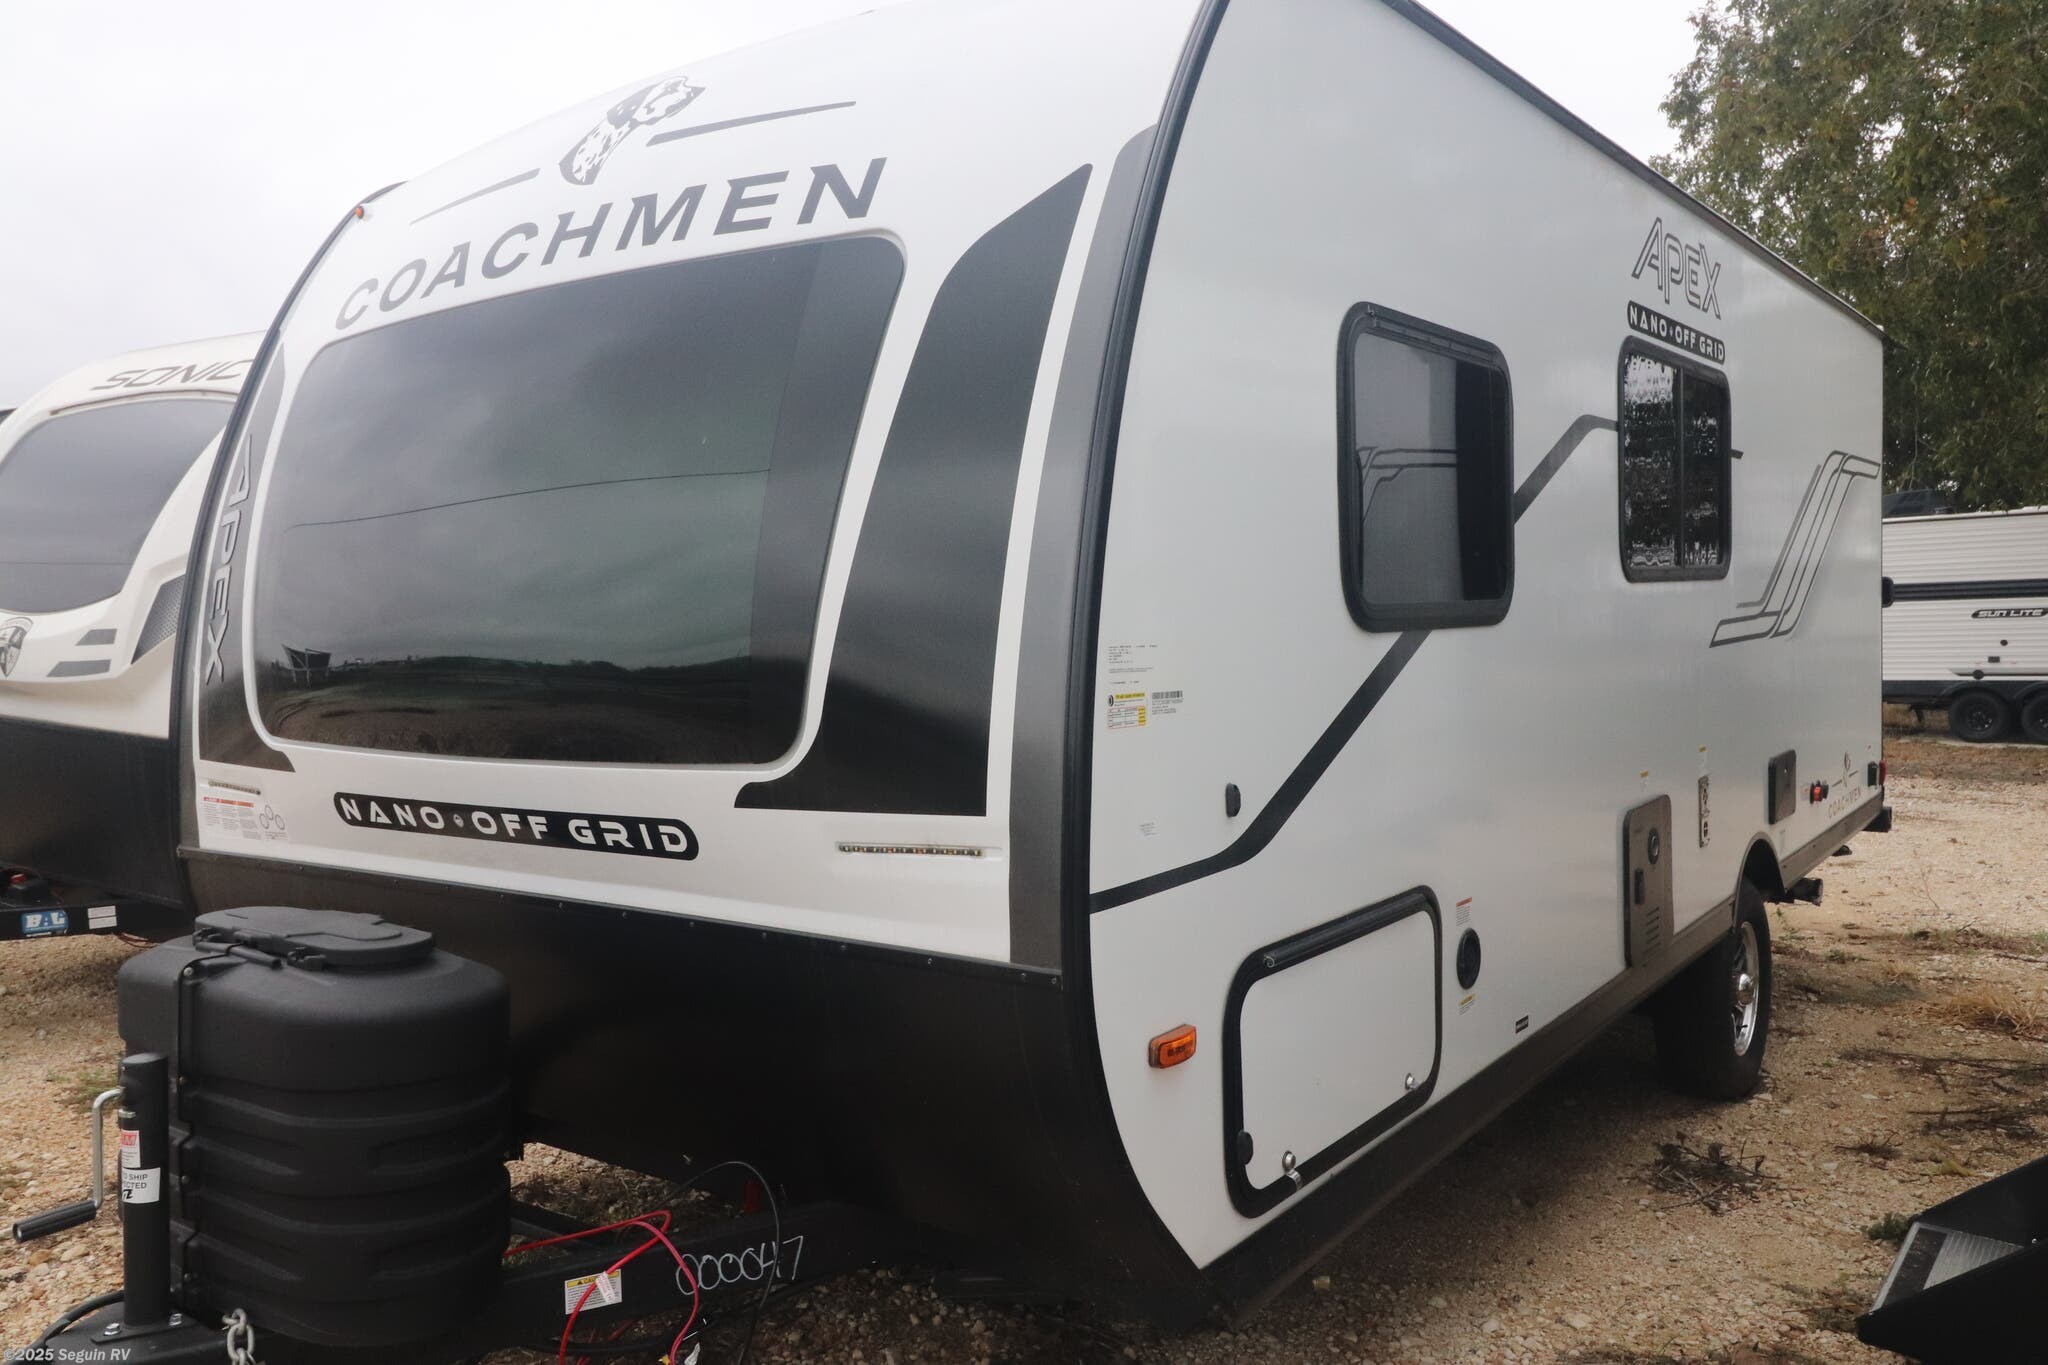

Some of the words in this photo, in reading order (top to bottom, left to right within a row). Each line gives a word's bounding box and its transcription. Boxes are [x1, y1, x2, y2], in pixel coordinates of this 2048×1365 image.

[335, 157, 888, 330] COACHMEN
[1631, 216, 1722, 320] APEX
[1629, 305, 1668, 338] NANO
[1674, 325, 1697, 349] OFF
[1699, 336, 1725, 361] GRID
[89, 358, 255, 391] SONIC
[204, 432, 253, 686] APEX
[1977, 610, 2008, 618] SUN
[2009, 609, 2044, 617] LITE
[340, 797, 445, 830] NANO
[470, 810, 549, 840] OFF
[567, 818, 689, 853] GRID
